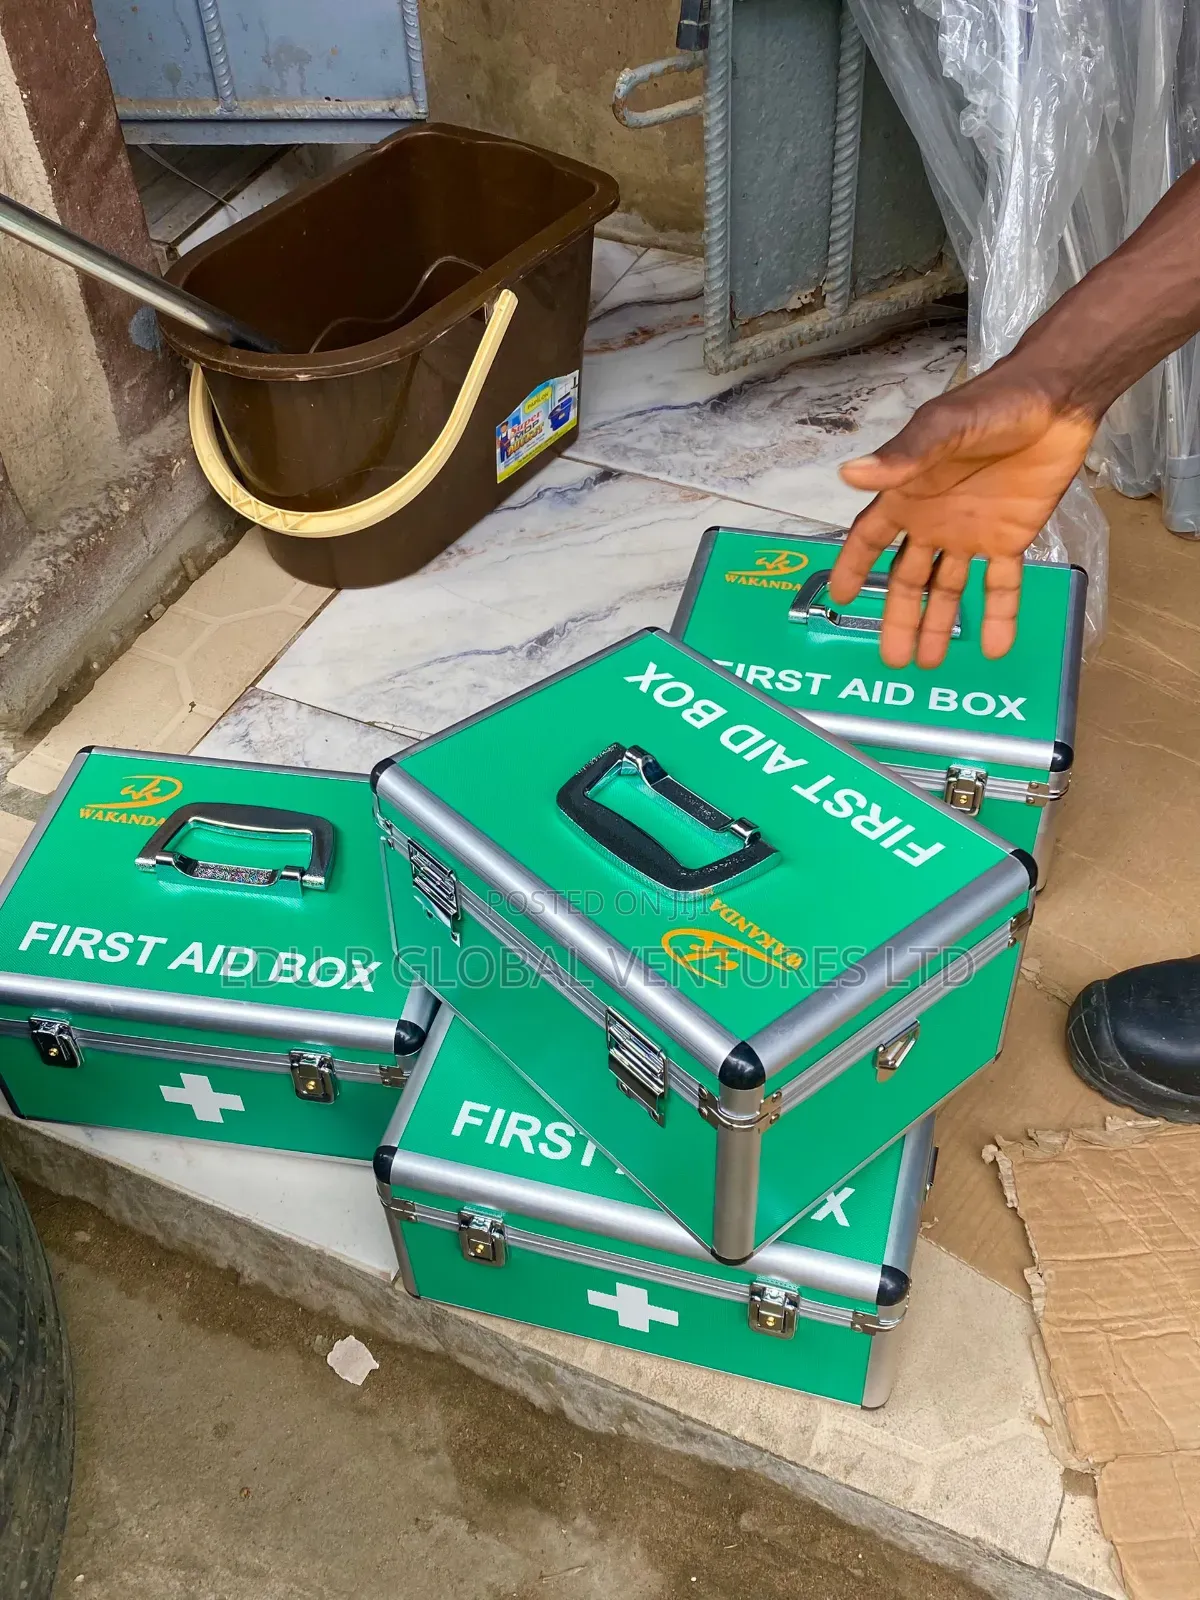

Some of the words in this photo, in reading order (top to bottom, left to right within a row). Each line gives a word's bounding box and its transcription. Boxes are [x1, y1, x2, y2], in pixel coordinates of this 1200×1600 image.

[511, 412, 541, 434] Super
[514, 419, 540, 440] MOP
[725, 574, 803, 591] WAKANDA
[624, 662, 728, 729] BOX
[712, 659, 832, 696] IRST
[838, 677, 915, 706] AID
[928, 686, 1026, 721] BOX
[720, 725, 808, 774] AID
[80, 808, 166, 827] WAKANDA
[791, 775, 945, 867] FIRST
[18, 921, 168, 966] FIRST
[167, 941, 258, 977] AID
[268, 951, 382, 992] BOX
[711, 899, 803, 970] WAKANDA
